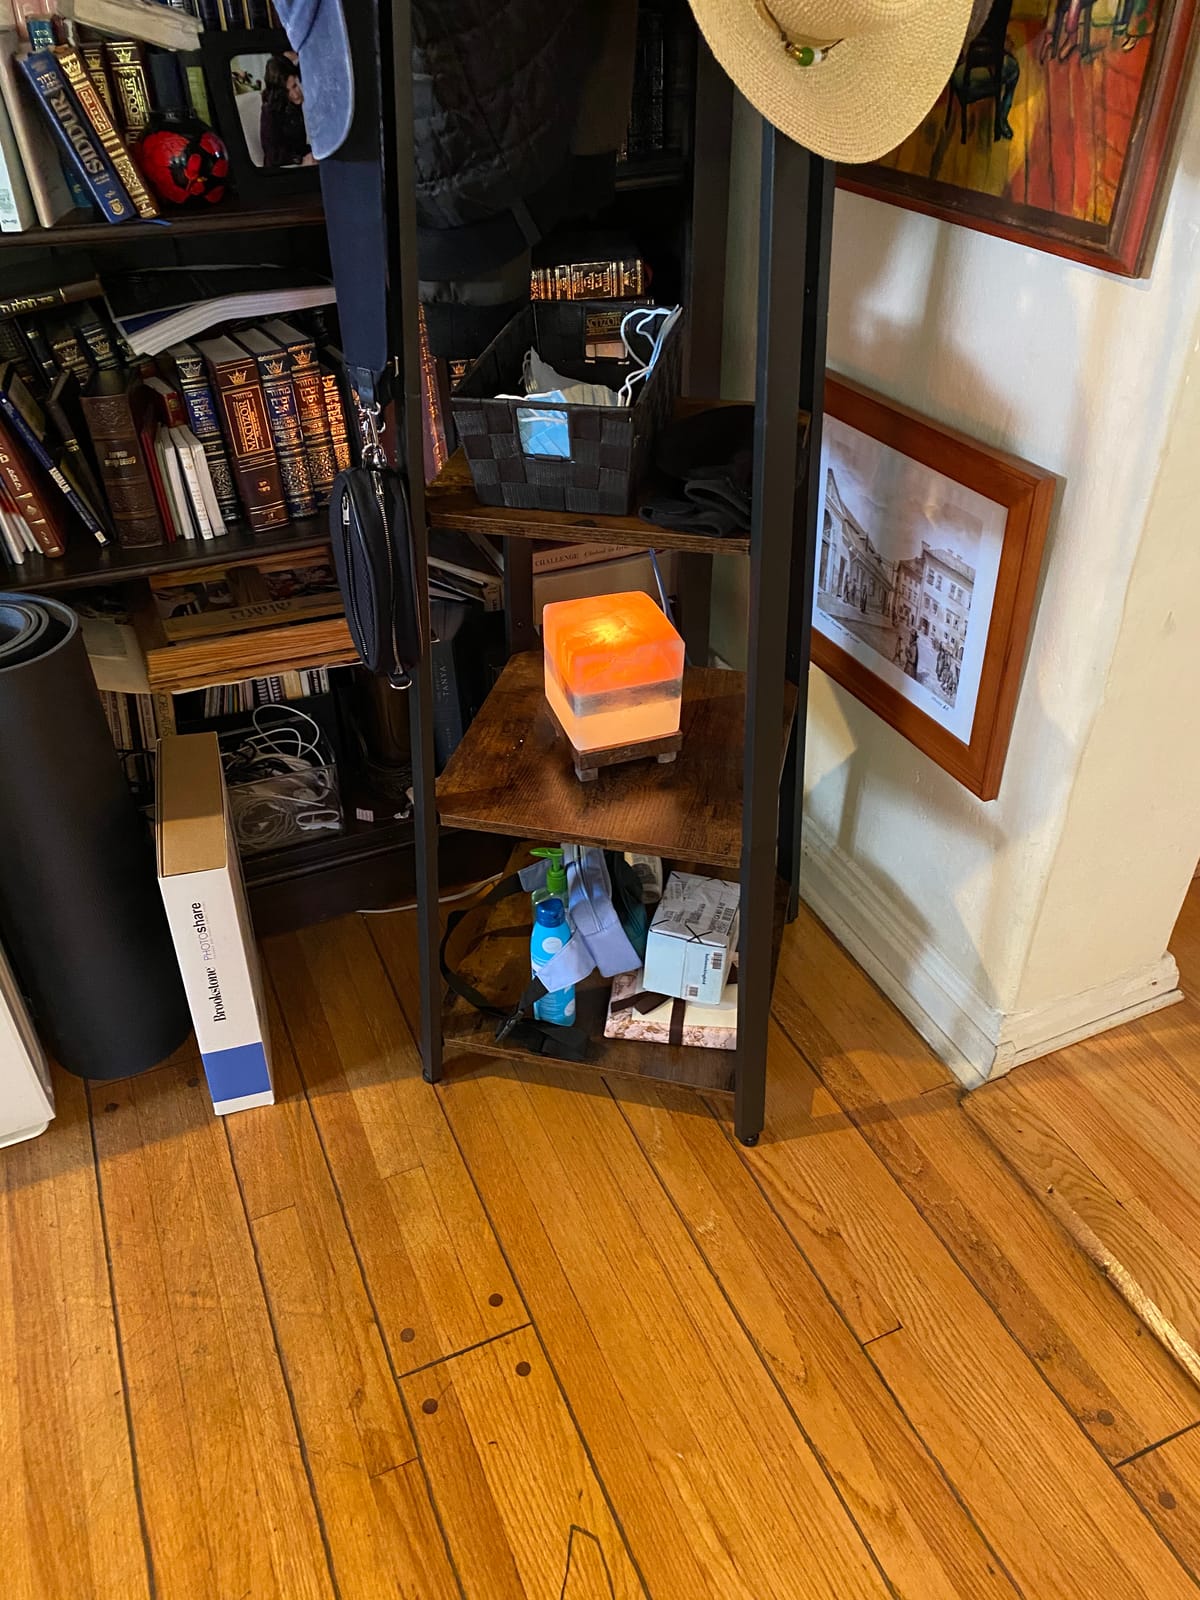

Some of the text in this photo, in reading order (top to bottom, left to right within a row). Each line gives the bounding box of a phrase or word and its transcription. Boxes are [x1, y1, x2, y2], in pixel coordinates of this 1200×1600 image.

[50, 88, 105, 174] SIDDUR
[440, 664, 449, 697] TANYA
[205, 966, 227, 1022] Brookstone
